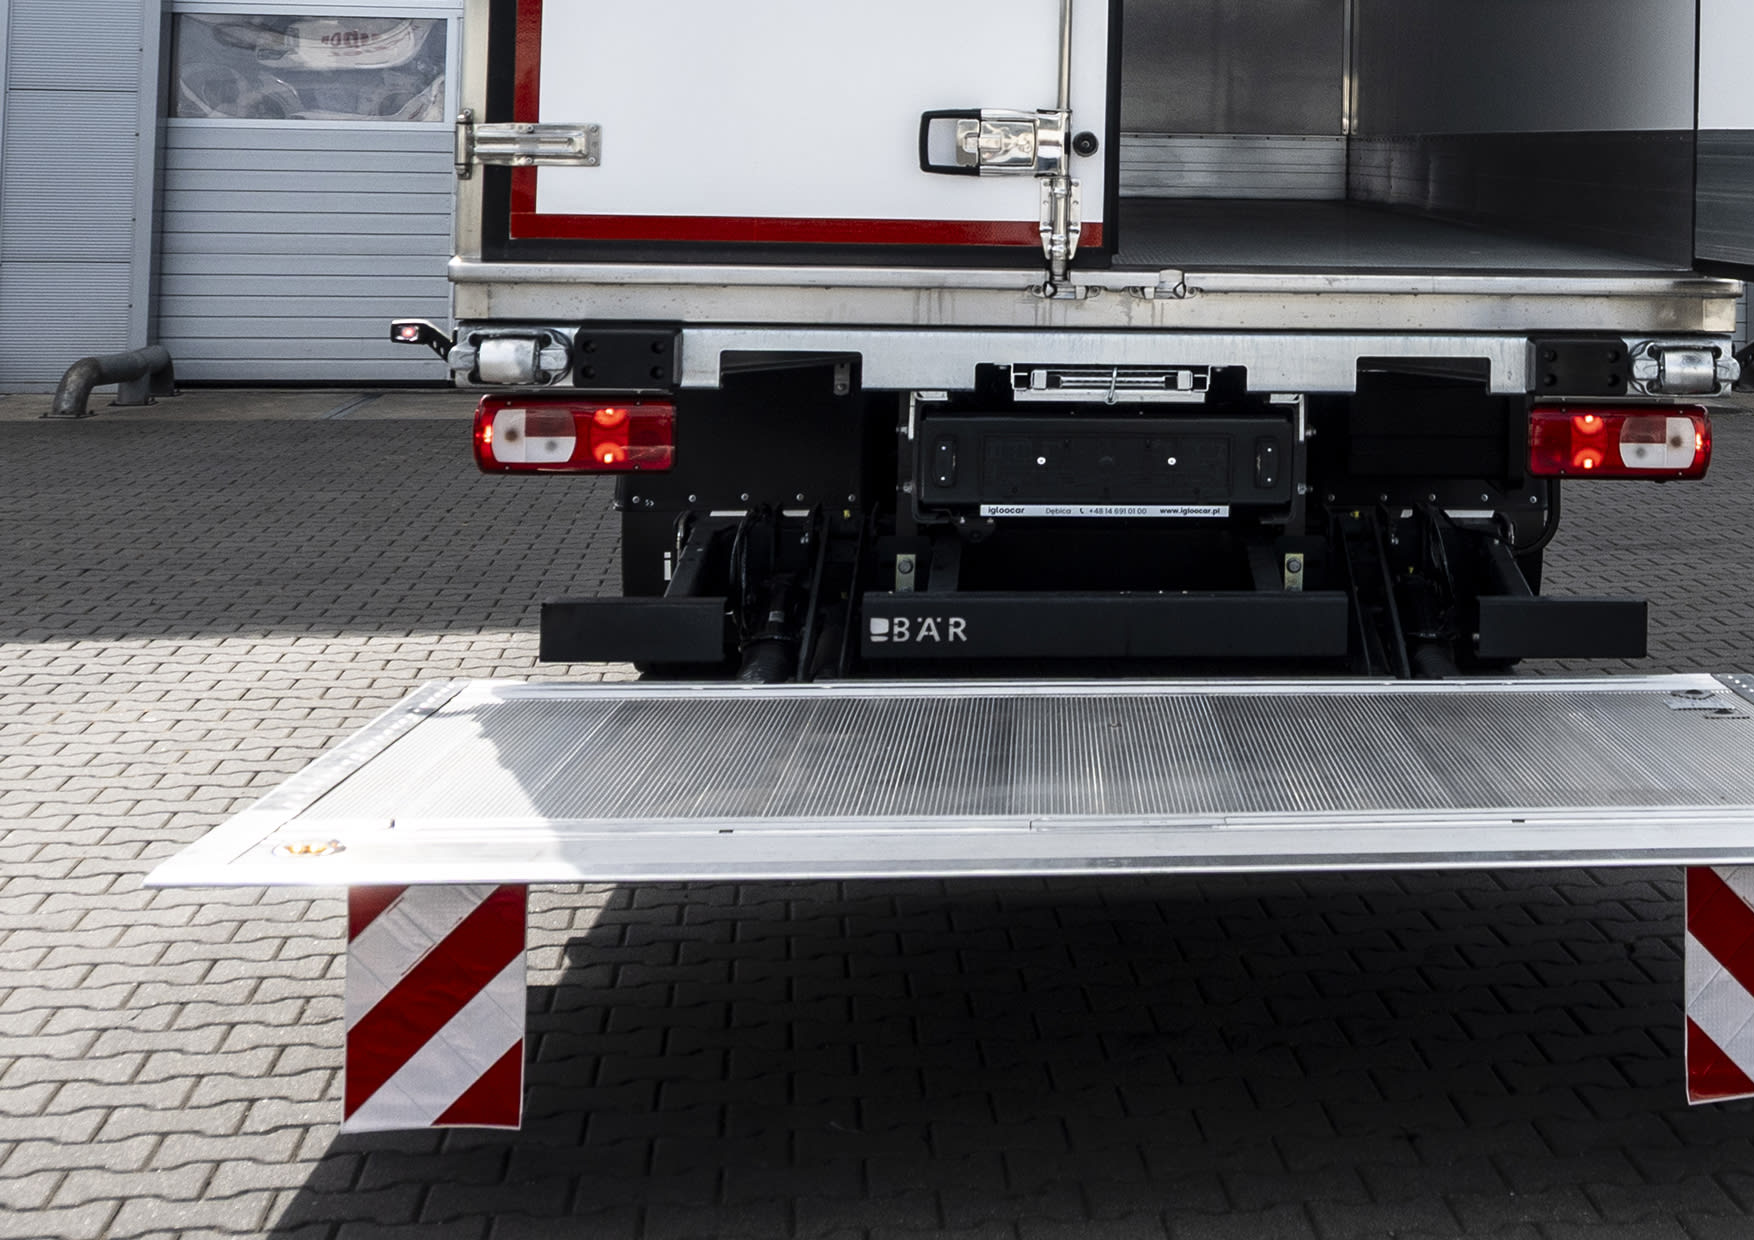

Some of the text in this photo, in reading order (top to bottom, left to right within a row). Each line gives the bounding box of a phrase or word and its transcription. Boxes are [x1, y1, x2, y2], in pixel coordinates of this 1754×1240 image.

[988, 506, 1025, 515] igloocar
[1105, 507, 1113, 515] 14
[1127, 507, 1136, 515] 01
[1160, 507, 1220, 516] www.igloocar.pl
[892, 617, 967, 642] BÄR
